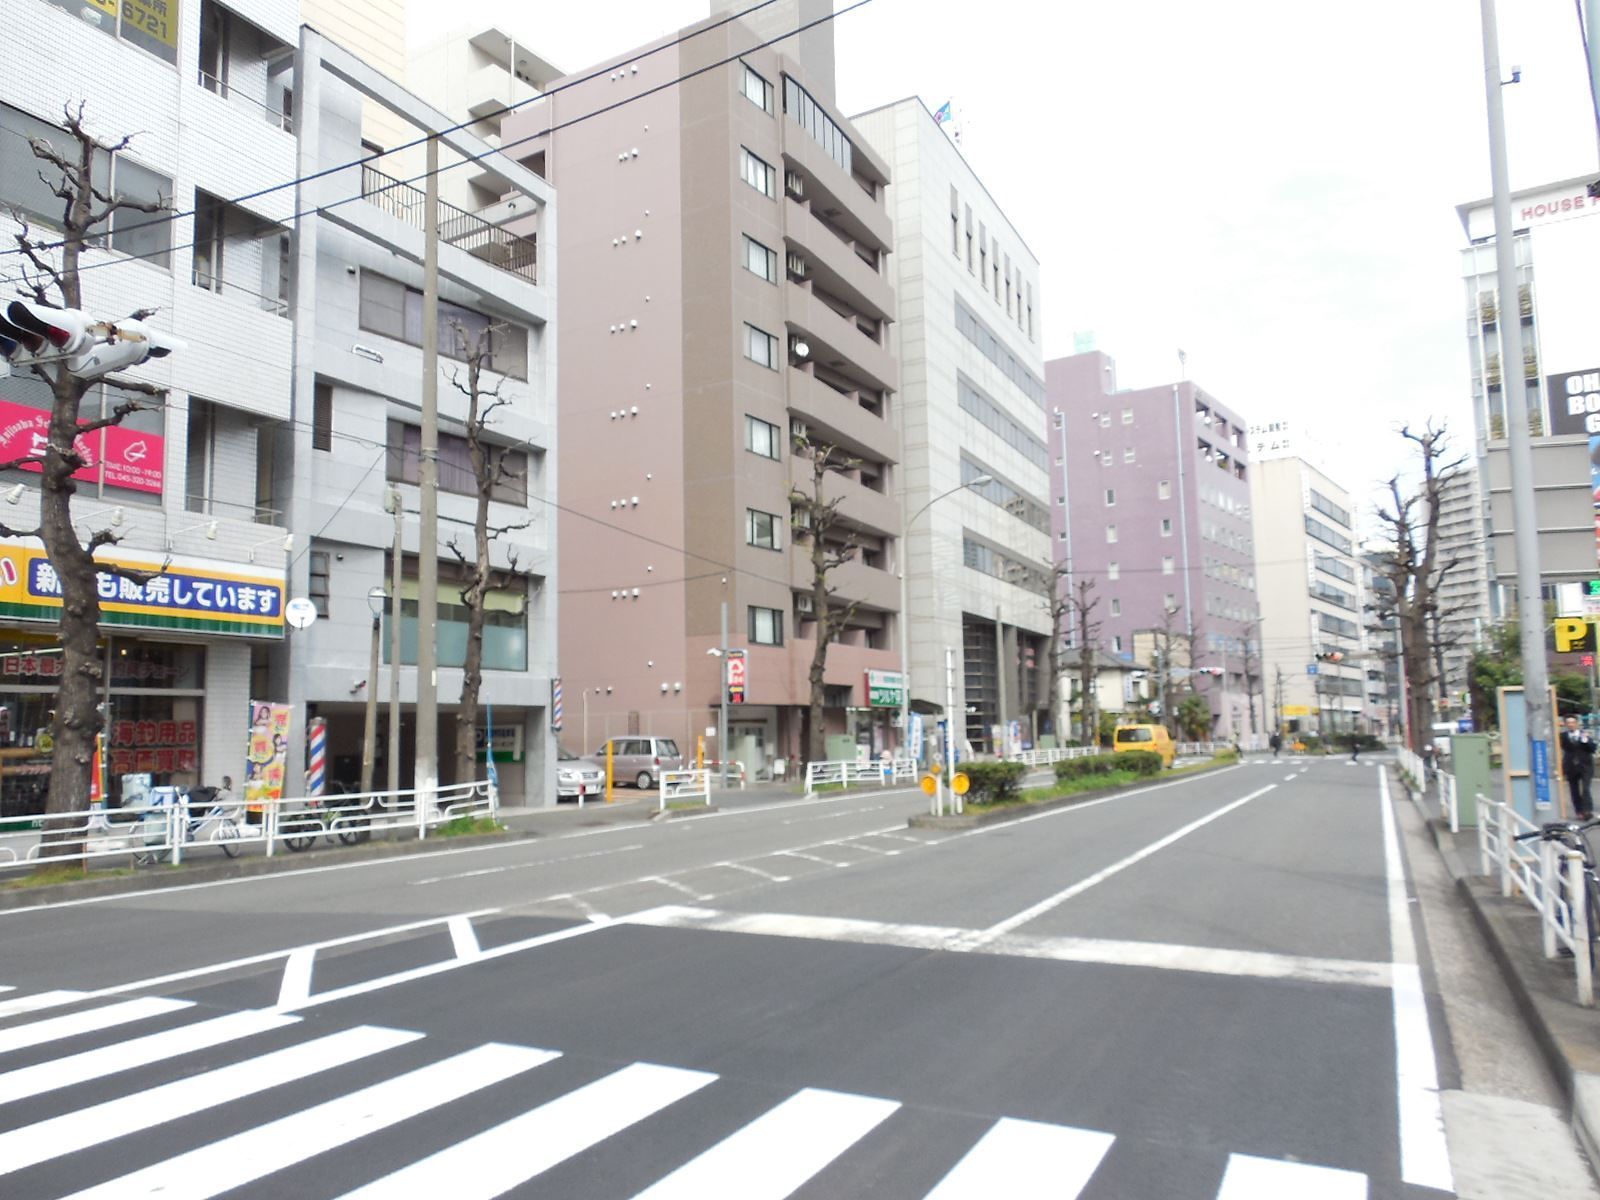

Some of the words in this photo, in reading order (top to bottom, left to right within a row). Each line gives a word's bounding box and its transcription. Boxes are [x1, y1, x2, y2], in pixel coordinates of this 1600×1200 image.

[1521, 195, 1585, 221] HOUSE
[36, 562, 277, 613] 新も販売しています
[1555, 617, 1588, 653] P
[111, 720, 197, 745] 海釣用品
[111, 748, 197, 774] 高価買取
